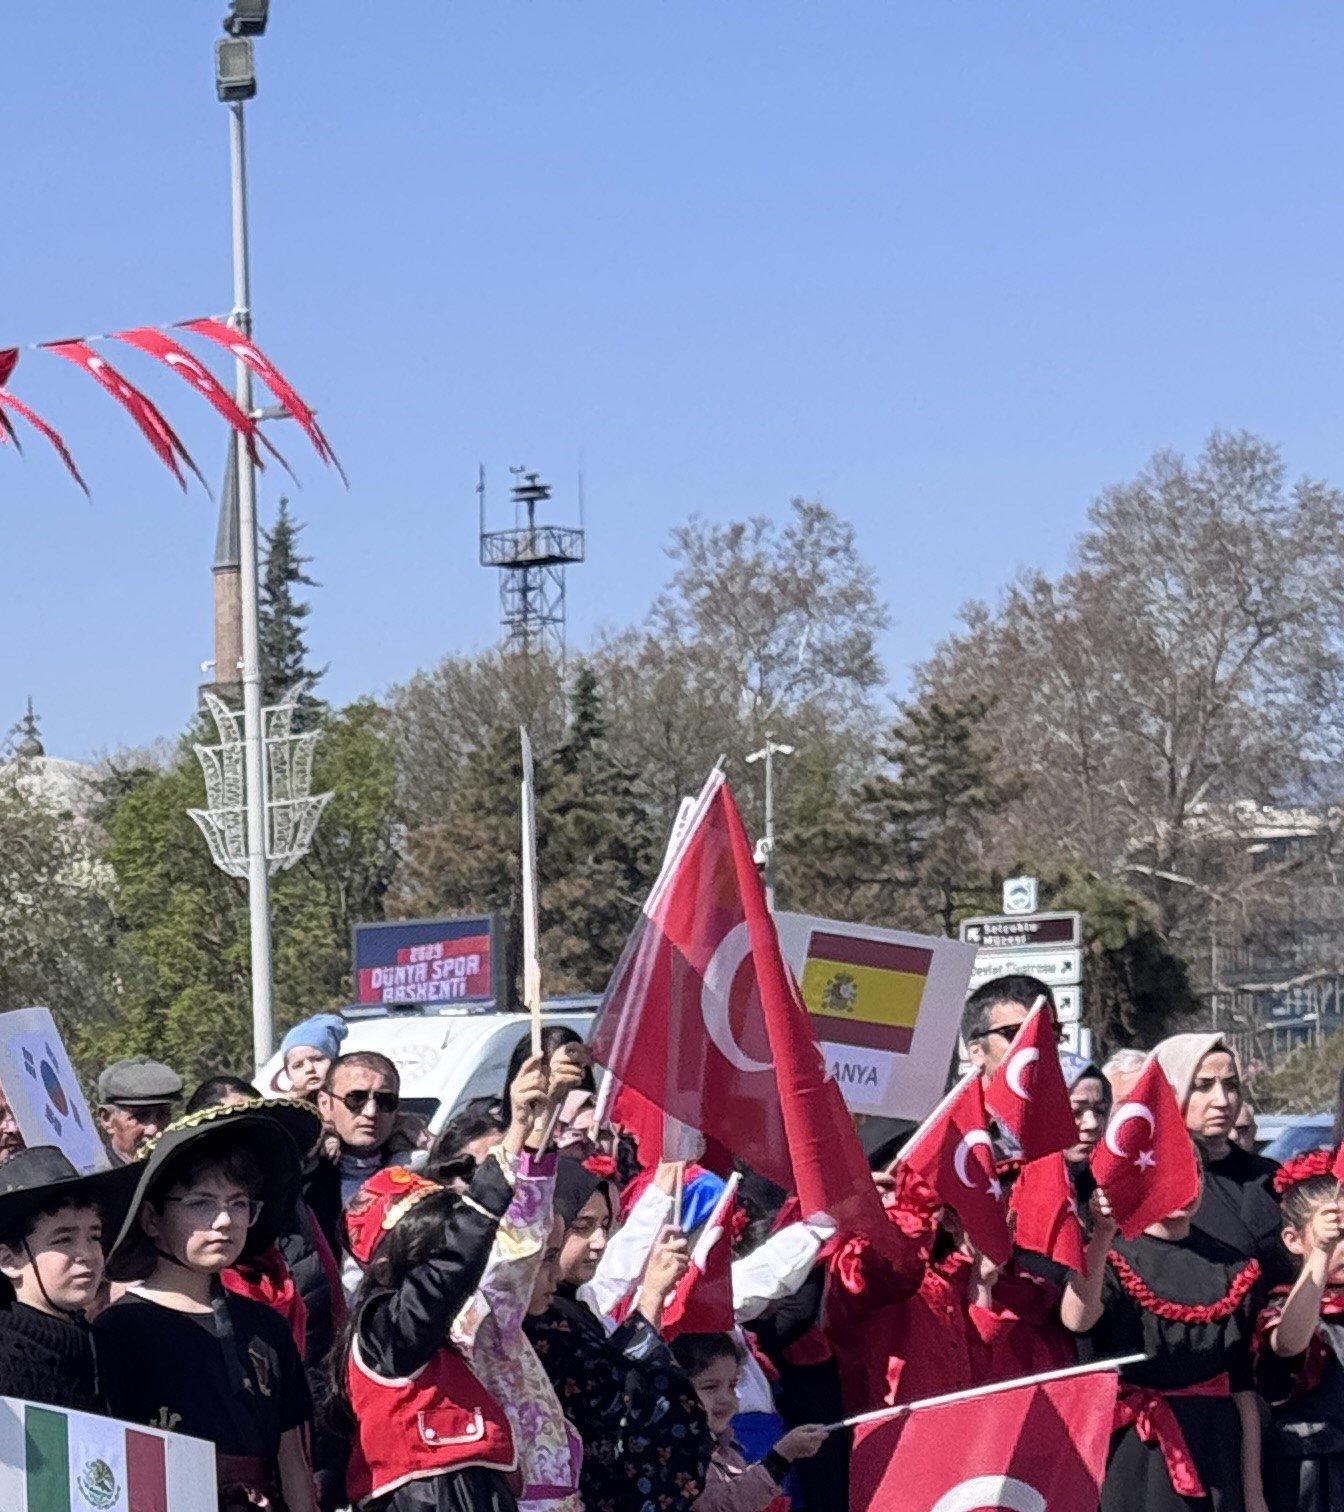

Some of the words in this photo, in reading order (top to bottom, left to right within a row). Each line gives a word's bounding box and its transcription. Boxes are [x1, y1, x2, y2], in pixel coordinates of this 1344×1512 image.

[371, 962, 428, 989] DÜNYA
[431, 954, 481, 979] SPOR
[832, 1061, 878, 1087] ANYA
